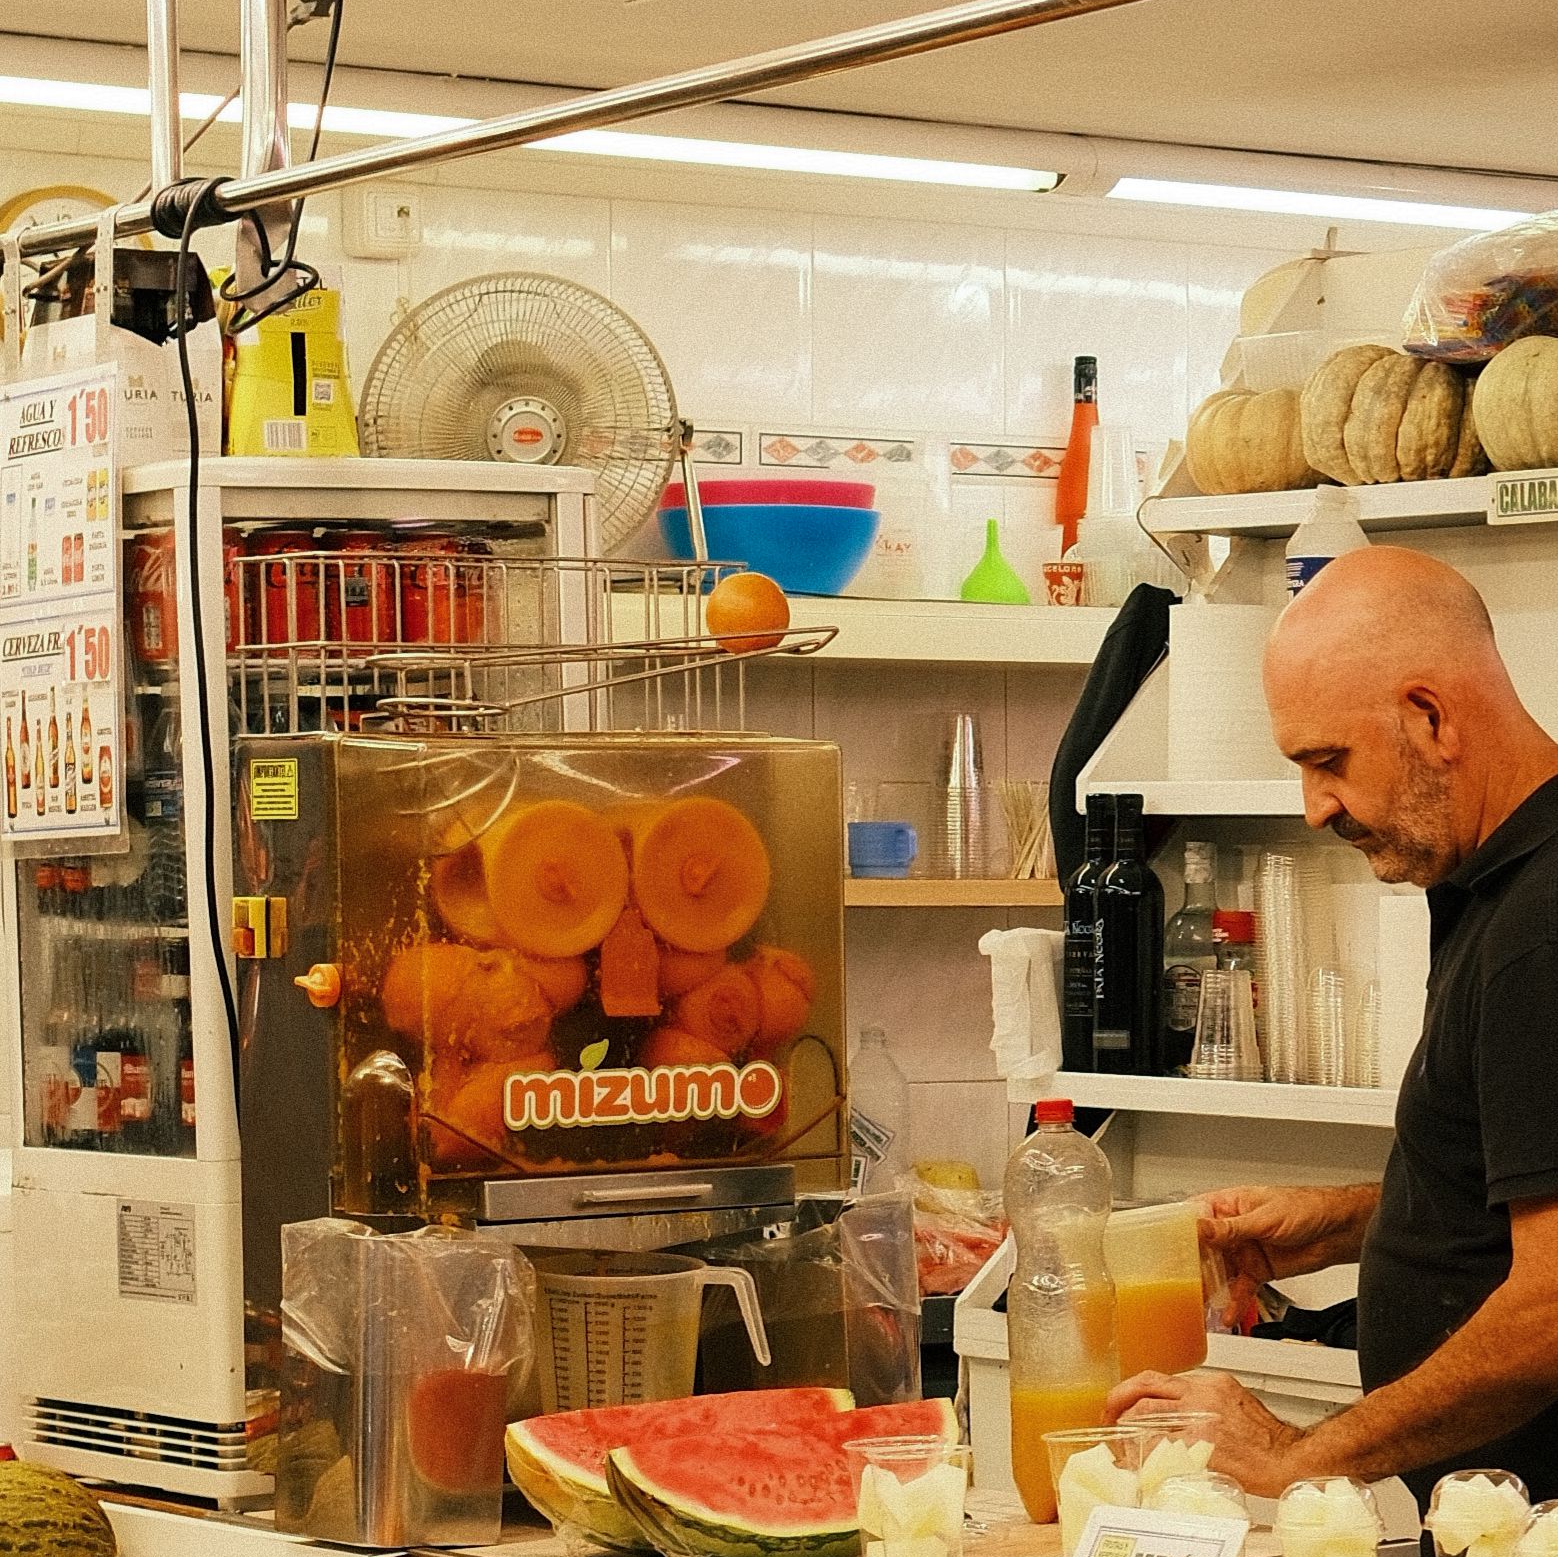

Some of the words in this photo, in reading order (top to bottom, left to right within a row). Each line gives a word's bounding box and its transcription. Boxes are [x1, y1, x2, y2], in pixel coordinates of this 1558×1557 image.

[123, 390, 158, 401] URIA
[8, 428, 64, 456] REFRESCO
[506, 1062, 780, 1128] mizumo
